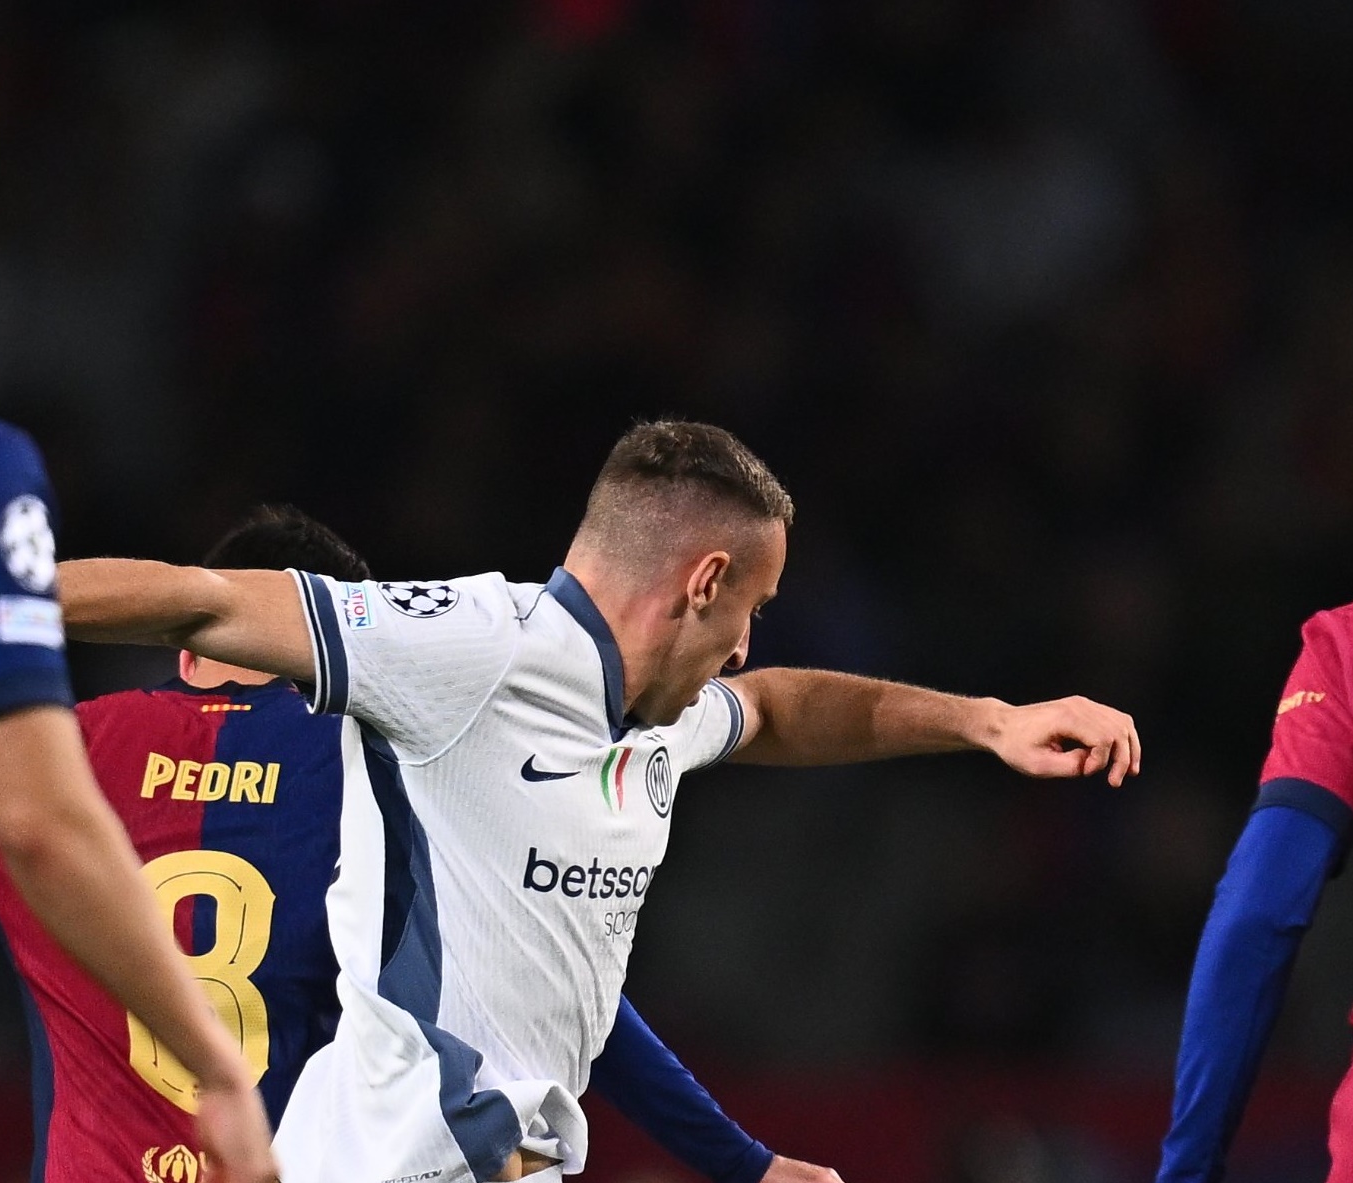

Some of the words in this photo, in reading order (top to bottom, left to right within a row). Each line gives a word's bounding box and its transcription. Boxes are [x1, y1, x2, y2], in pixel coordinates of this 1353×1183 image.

[350, 586, 368, 628] ATION
[138, 750, 281, 804] PEDRI
[604, 910, 637, 942] spo
[127, 850, 277, 1117] 8
